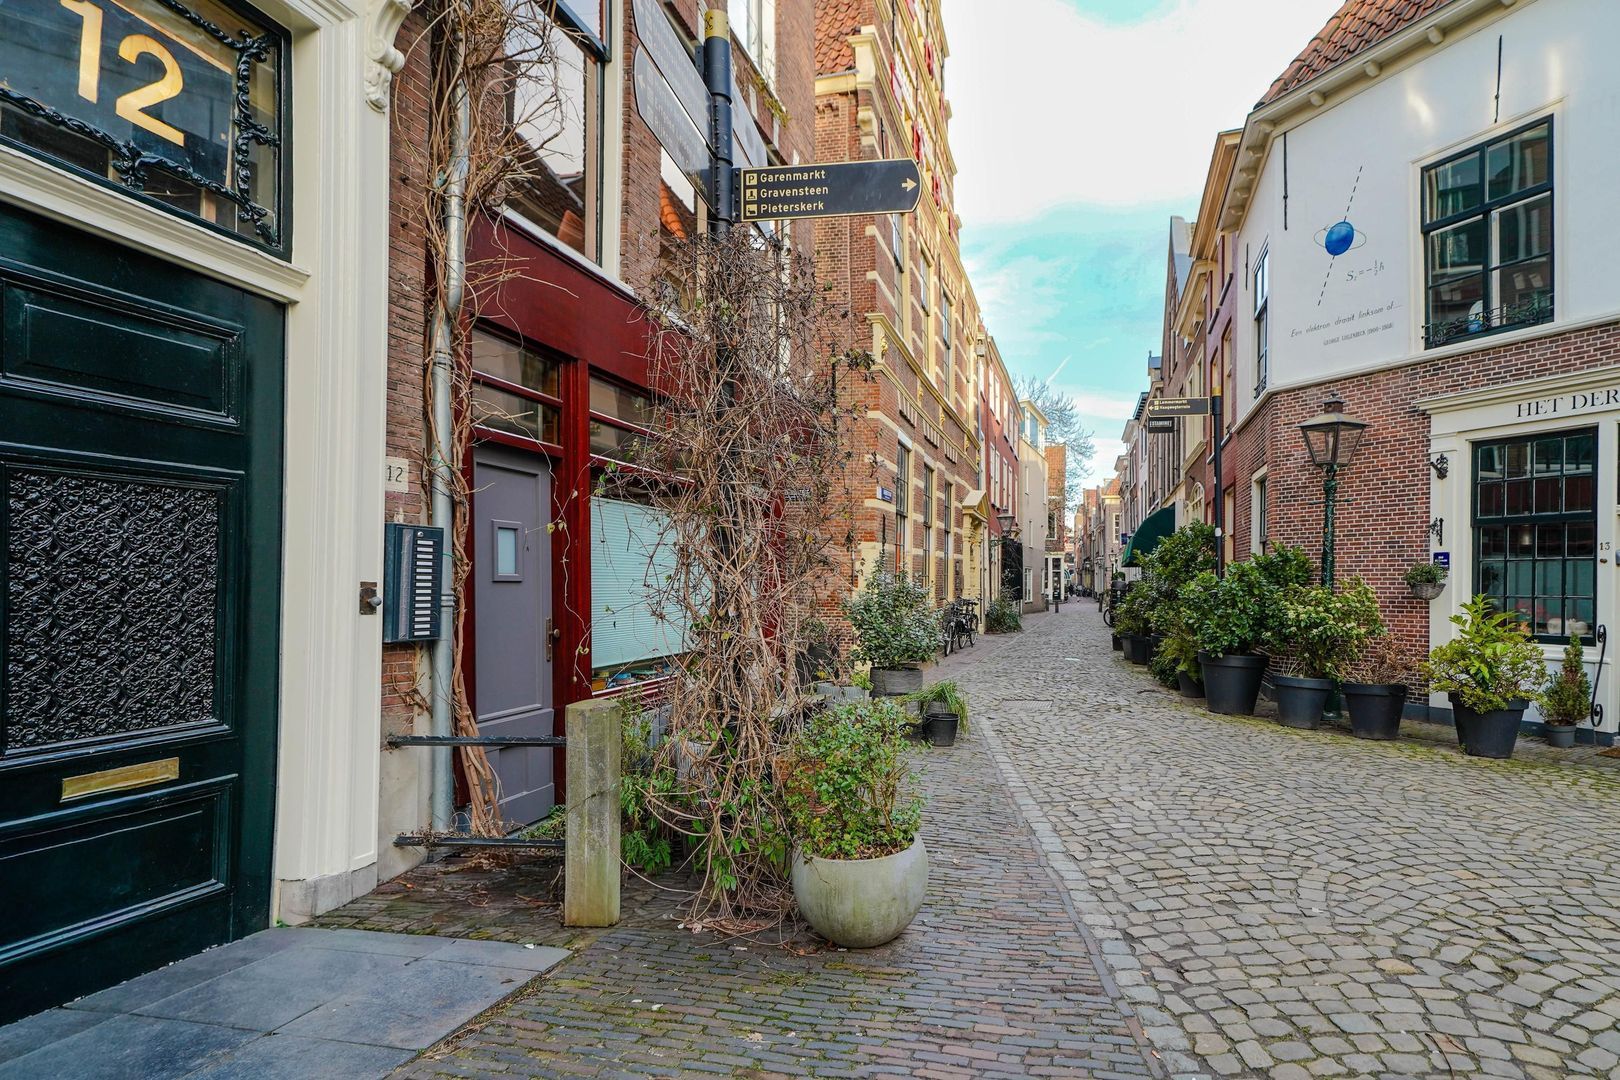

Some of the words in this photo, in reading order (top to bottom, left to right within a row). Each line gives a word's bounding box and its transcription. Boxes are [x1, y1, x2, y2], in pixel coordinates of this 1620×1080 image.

[60, 0, 185, 147] 12
[760, 170, 826, 183] Garenmarkt
[760, 185, 829, 198] Gravensteen
[760, 201, 825, 214] Pieterskerk
[1517, 397, 1563, 418] HET
[1571, 389, 1619, 410] DER
[387, 465, 404, 483] 12
[1600, 541, 1610, 551] 13
